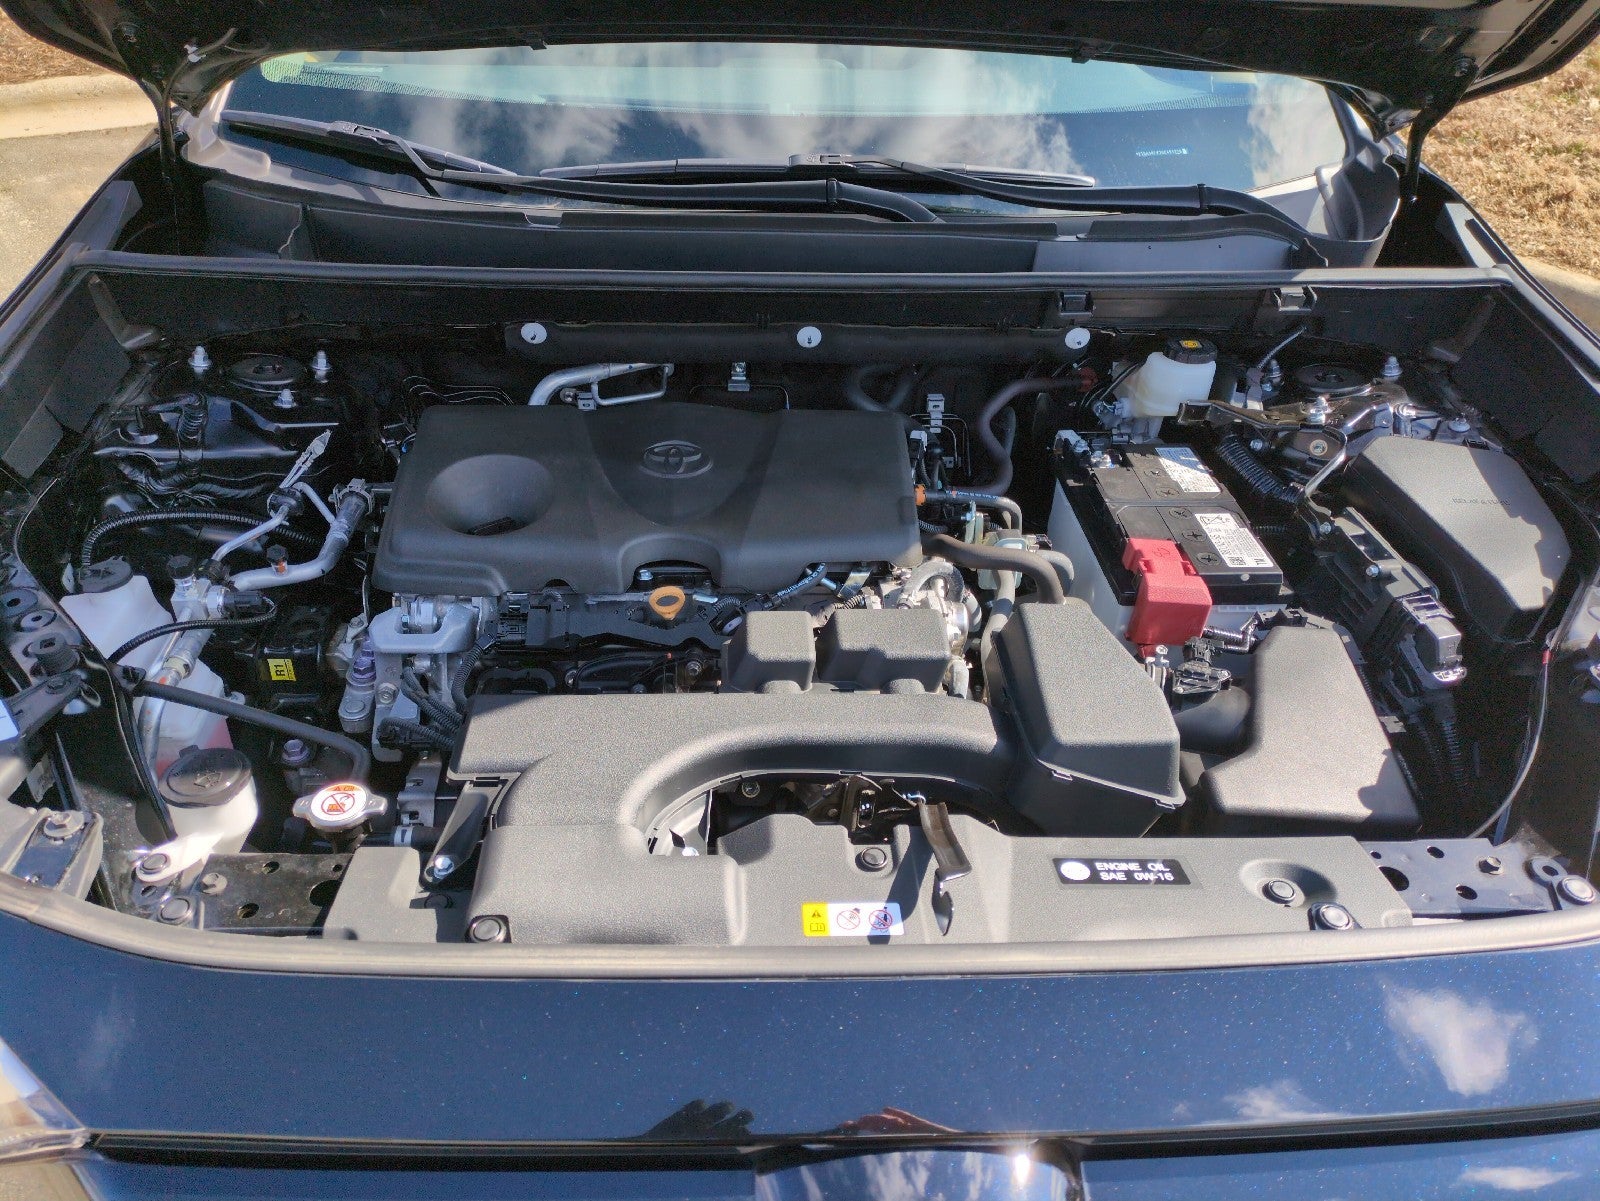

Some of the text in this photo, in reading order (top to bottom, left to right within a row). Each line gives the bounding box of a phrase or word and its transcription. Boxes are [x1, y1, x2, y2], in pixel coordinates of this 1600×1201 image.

[274, 664, 285, 676] R1
[1095, 862, 1170, 871] ENGINE OIL
[1100, 872, 1174, 881] SAE 0W-16
